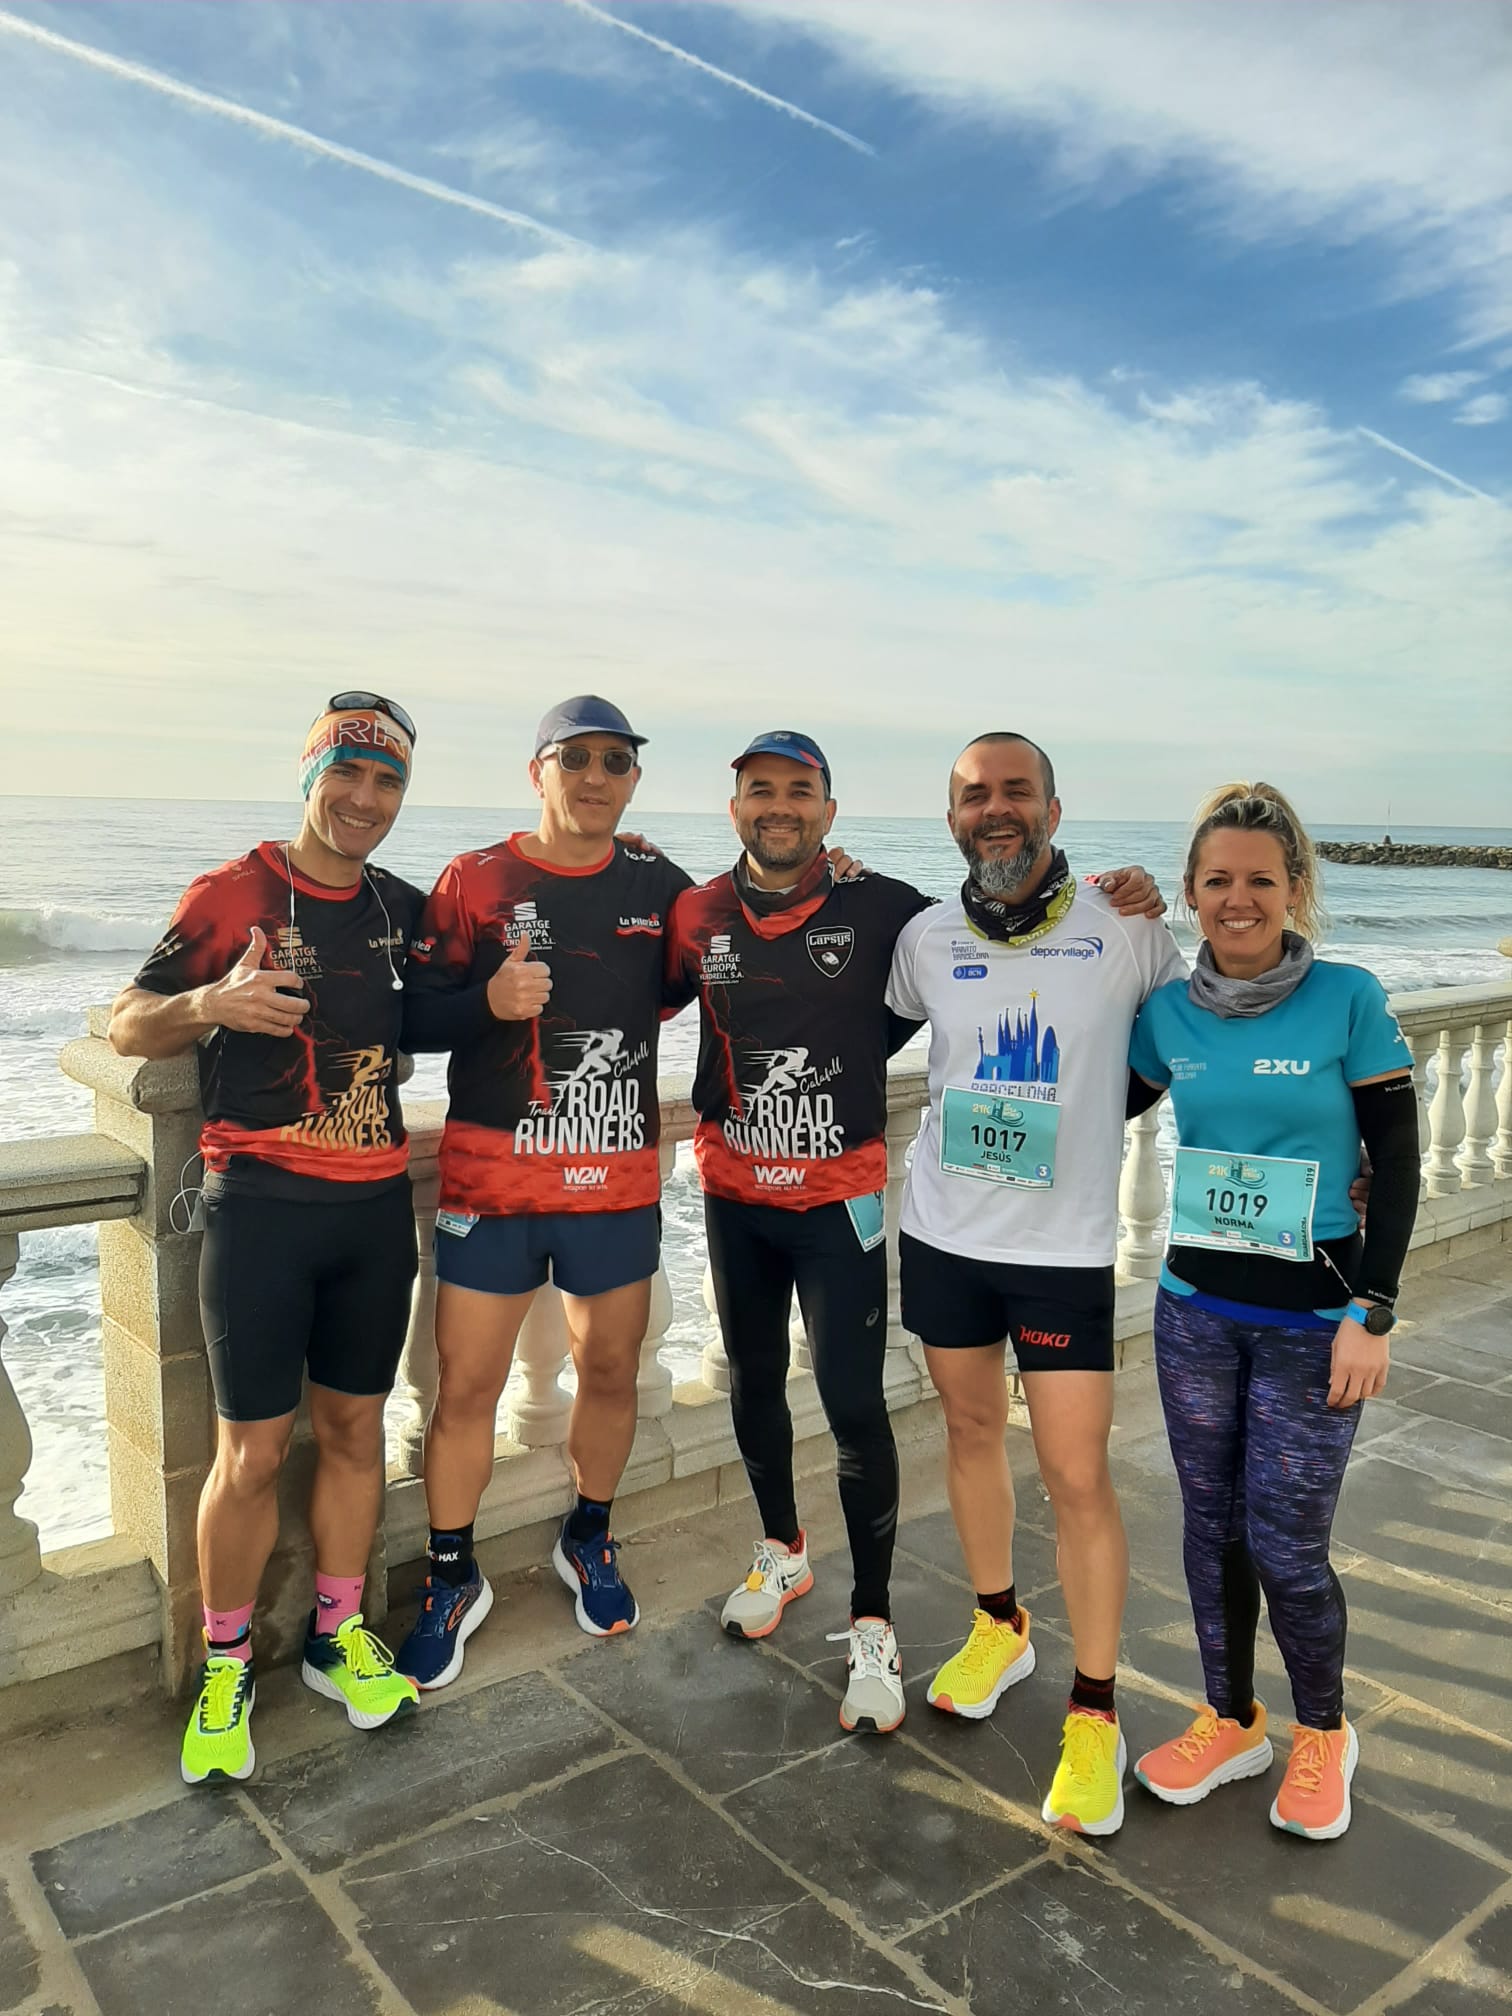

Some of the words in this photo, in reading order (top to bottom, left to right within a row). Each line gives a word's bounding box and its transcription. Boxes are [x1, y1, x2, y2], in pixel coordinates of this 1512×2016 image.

[504, 920, 551, 932] GARATGE
[269, 946, 318, 960] GARATGE
[701, 953, 741, 964] GARATGE
[1030, 945, 1095, 960] deporvillage
[703, 963, 737, 973] EUROPA
[1253, 1058, 1311, 1076] 2XU
[336, 1085, 389, 1120] ROAD
[567, 1078, 640, 1119] ROAD
[528, 1100, 560, 1117] Trail
[757, 1094, 834, 1129] ROAD
[280, 1117, 392, 1153] RUNNERS
[513, 1112, 645, 1154] RUNNERS
[723, 1118, 845, 1160] RUNNERS
[970, 1124, 1027, 1153] 1017
[980, 1151, 1012, 1164] JESÚS
[563, 1166, 609, 1185] W2W
[754, 1165, 806, 1185] W2W
[1039, 1165, 1047, 1177] 3
[1305, 1167, 1315, 1188] 1019
[1206, 1188, 1268, 1218] 1019
[1214, 1216, 1255, 1230] NORMA
[1281, 1232, 1291, 1244] 3
[438, 1551, 459, 1562] MAX
